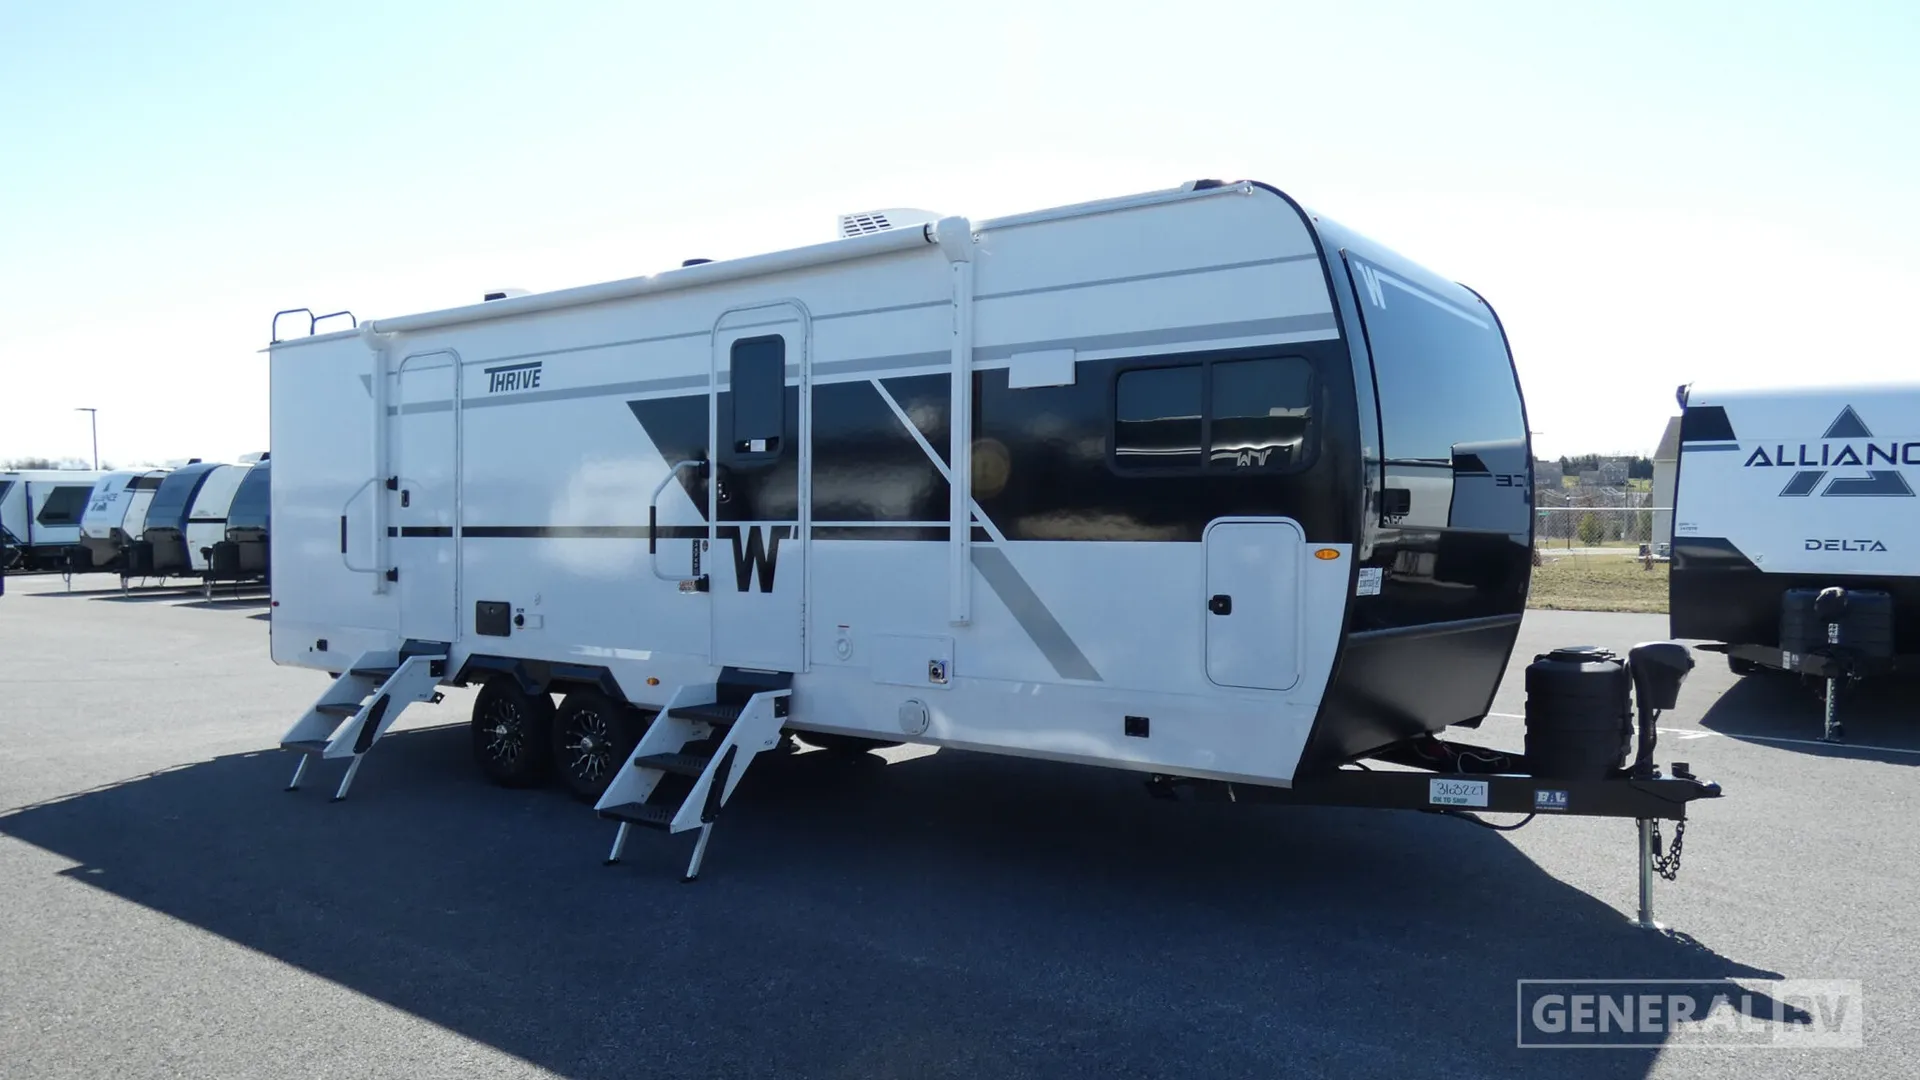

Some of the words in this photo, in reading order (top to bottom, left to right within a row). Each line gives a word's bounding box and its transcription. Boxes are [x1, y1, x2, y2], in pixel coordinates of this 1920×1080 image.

[484, 361, 542, 393] THRIVE
[728, 526, 791, 593] W
[1805, 539, 1887, 552] DELTA
